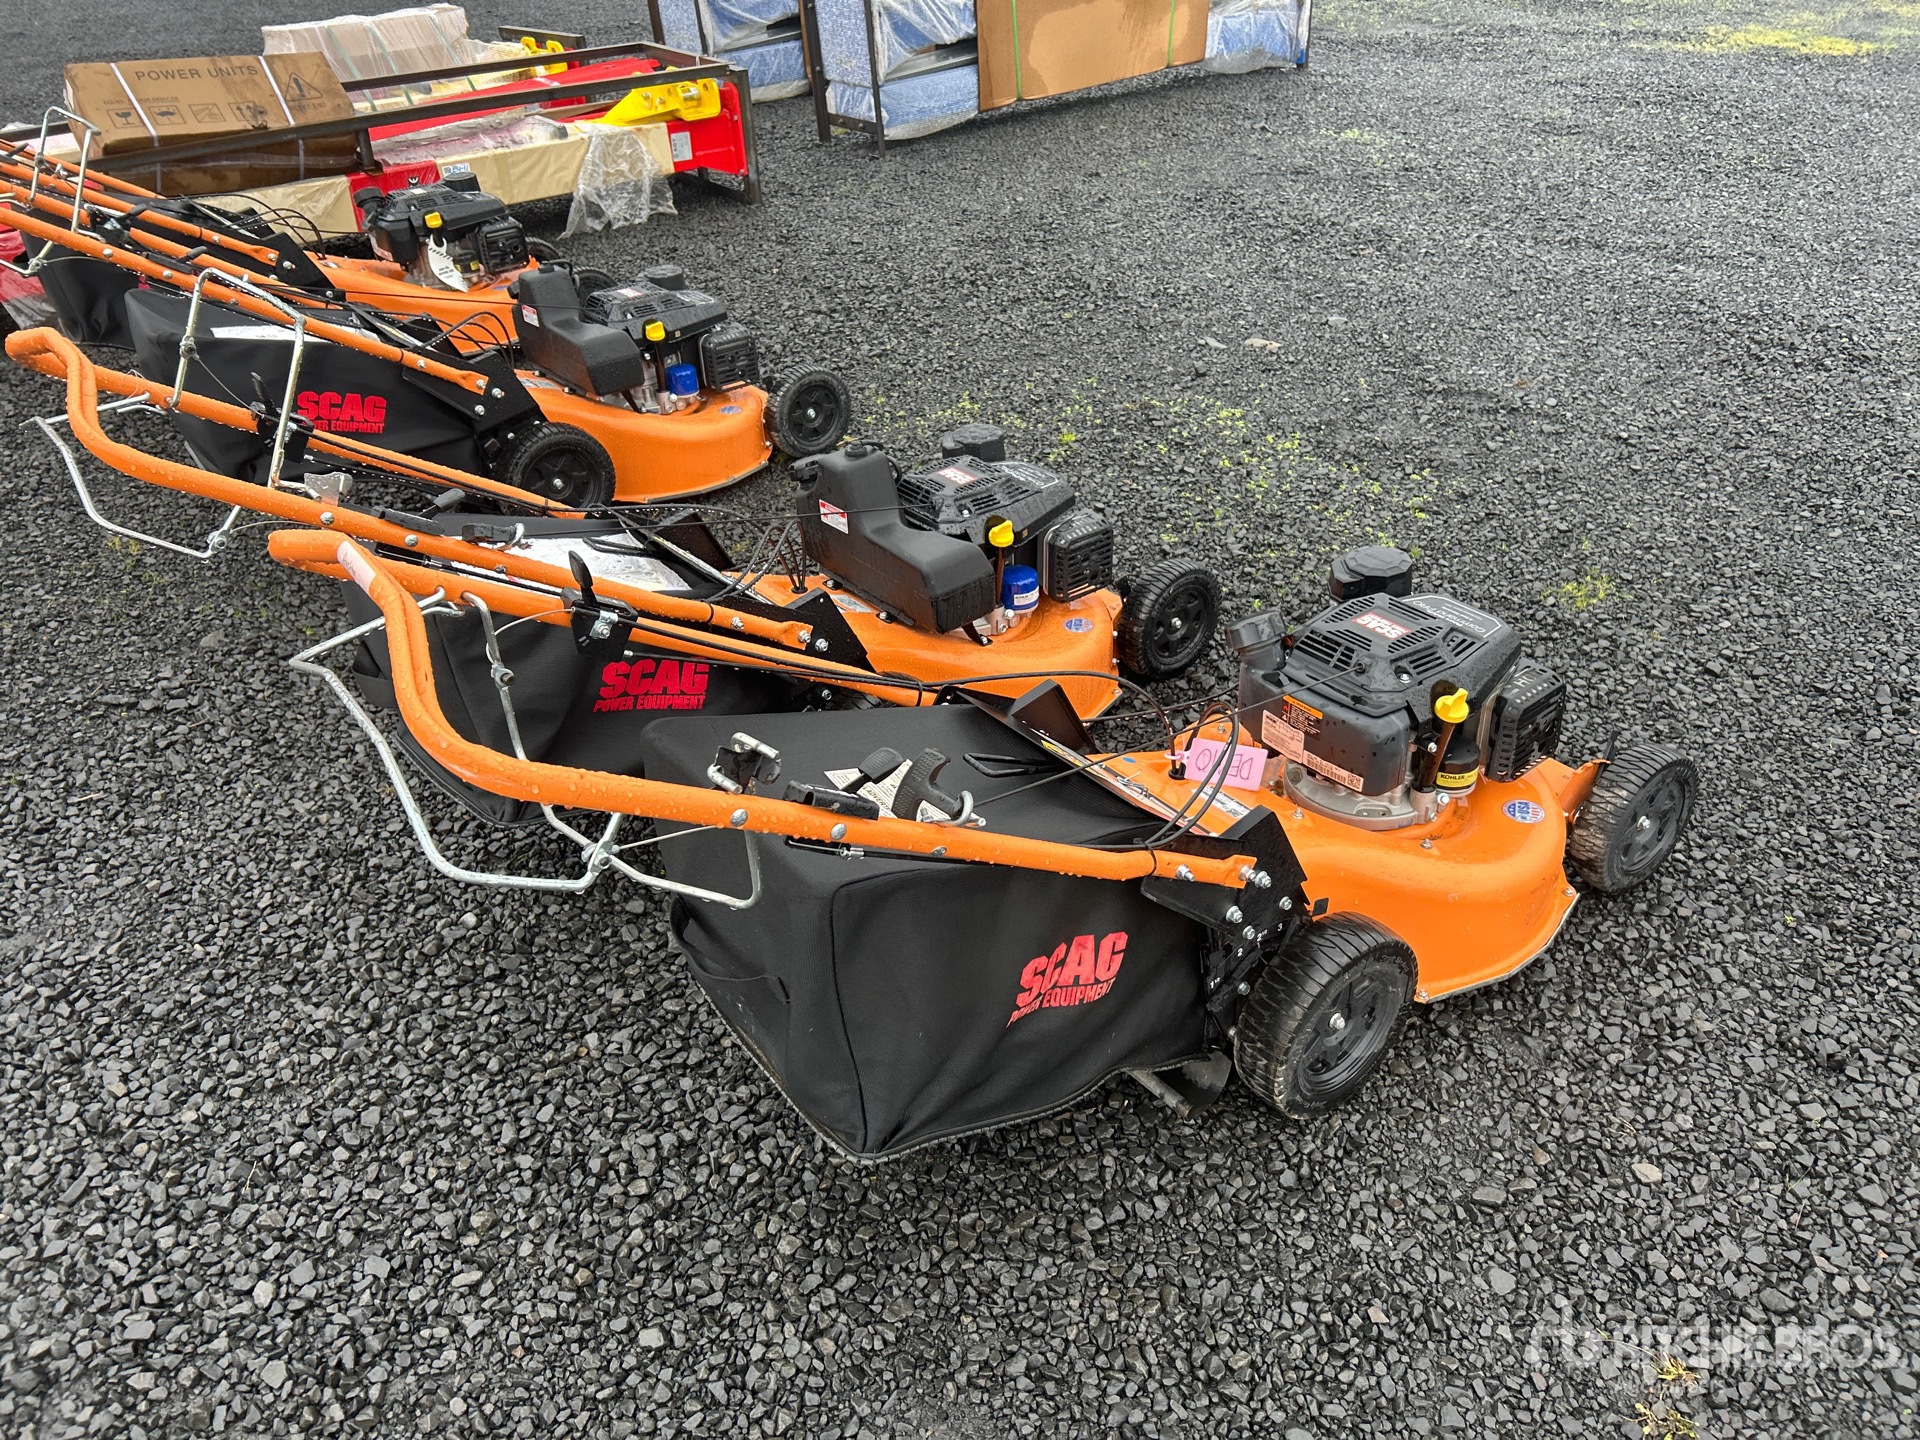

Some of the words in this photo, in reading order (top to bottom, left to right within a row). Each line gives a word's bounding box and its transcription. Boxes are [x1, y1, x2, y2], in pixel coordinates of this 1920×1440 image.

[135, 68, 202, 81] POWER
[206, 65, 259, 78] UNITS
[297, 390, 387, 423] SCAG
[330, 420, 385, 434] EQUIPMENT
[1355, 614, 1400, 638] SCAG
[599, 656, 710, 699] SCAG
[593, 696, 635, 713] POWER
[636, 693, 706, 711] EQUIPMENT
[1195, 748, 1254, 780] DEO
[1516, 801, 1531, 815] USA
[1277, 922, 1283, 932] 3
[1015, 931, 1128, 1008] SCAG
[1041, 976, 1117, 1009] EQUIPMENT
